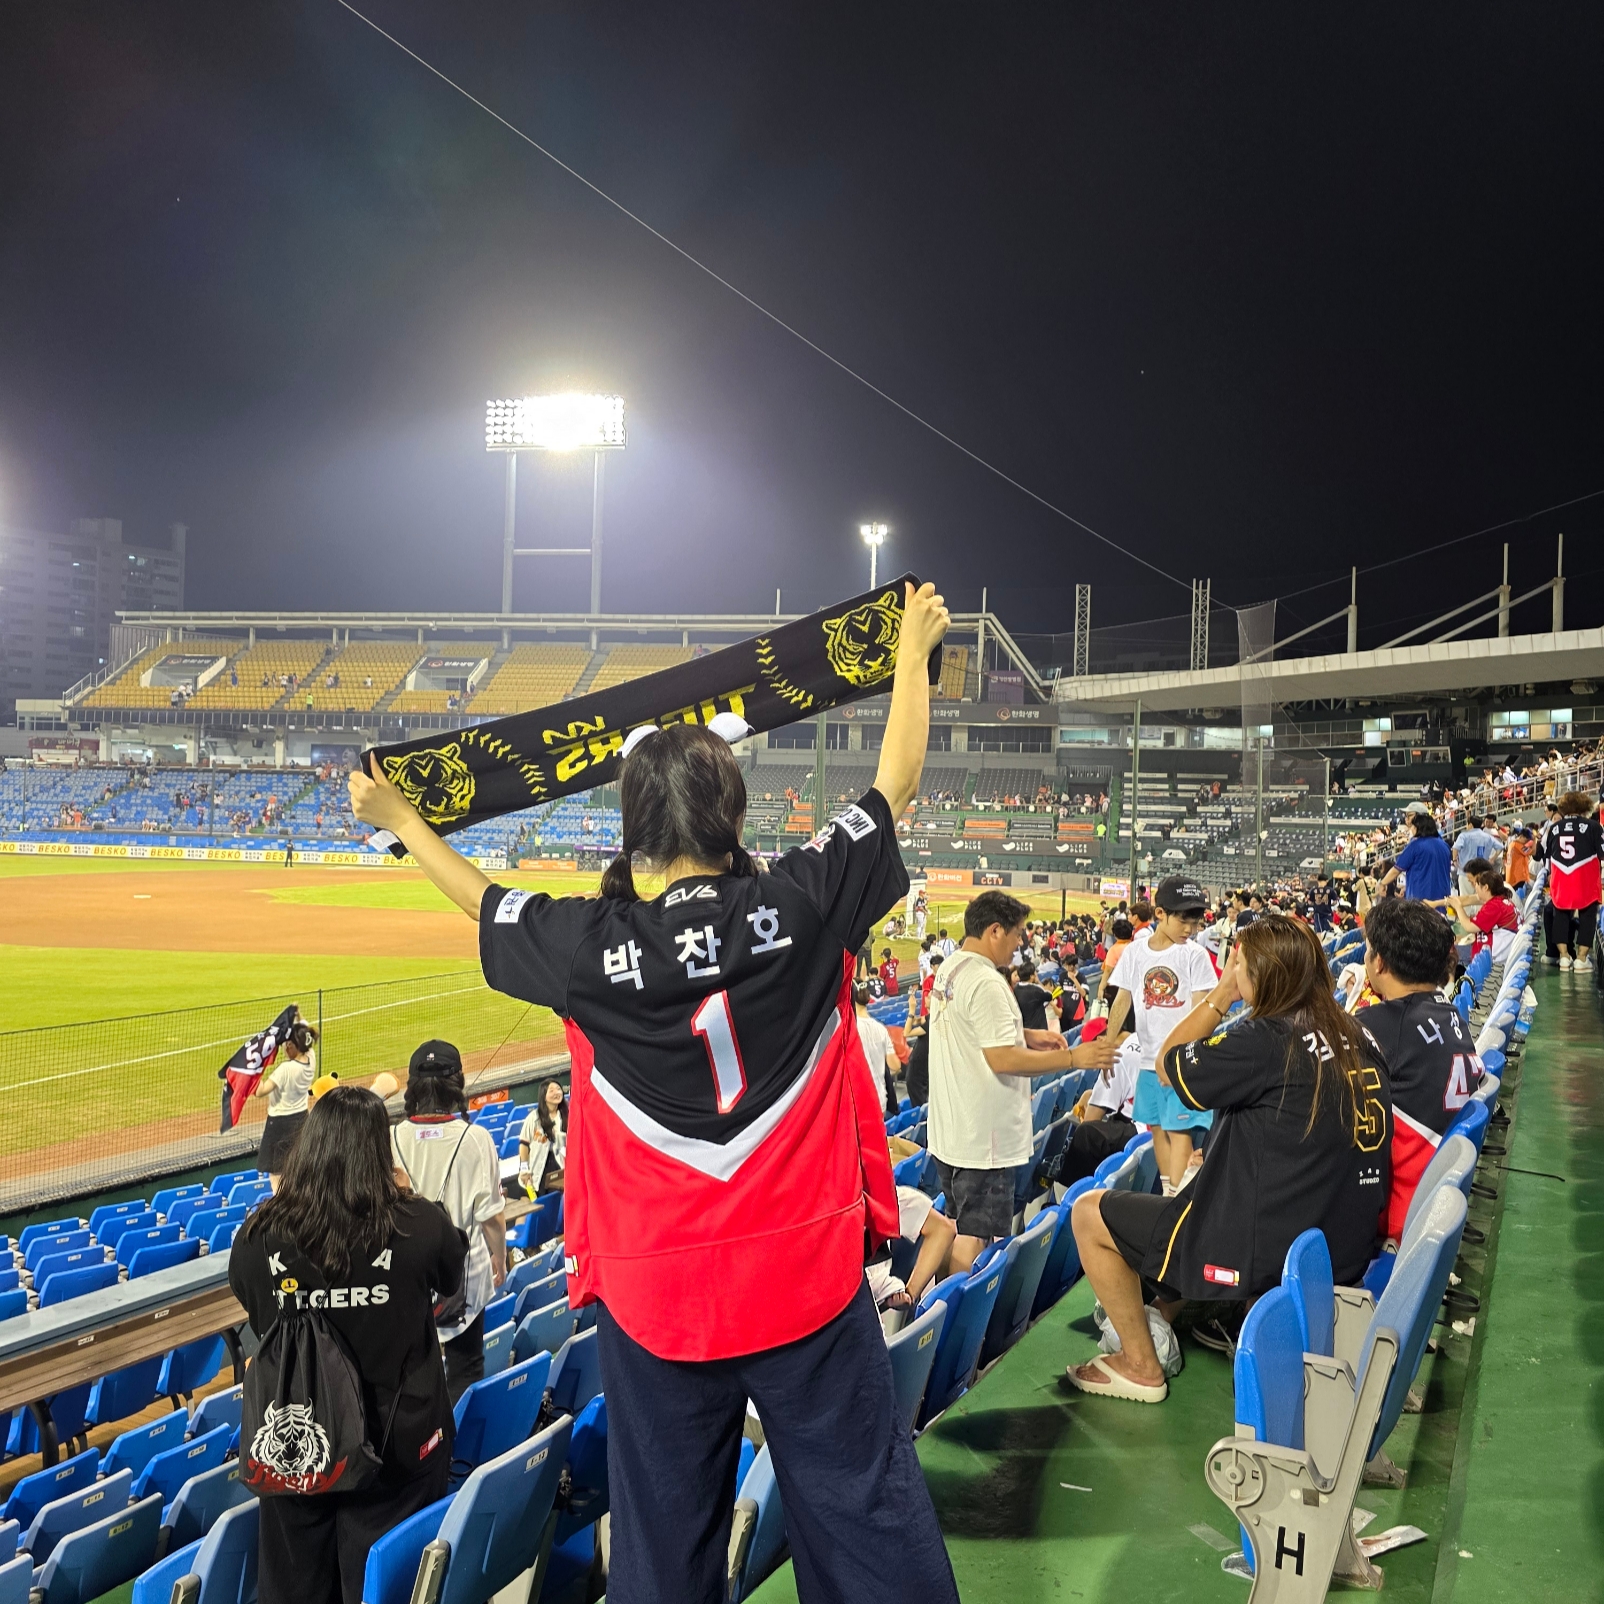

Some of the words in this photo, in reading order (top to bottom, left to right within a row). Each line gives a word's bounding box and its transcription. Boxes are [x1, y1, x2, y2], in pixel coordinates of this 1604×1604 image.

[856, 708, 883, 717] 한화생명
[1011, 710, 1040, 719] 한화생명
[38, 845, 70, 853] BESKO
[94, 846, 126, 854] BESKO
[1560, 836, 1575, 859] 5
[150, 848, 183, 857] BESKO
[208, 850, 240, 859] BESKO
[265, 852, 298, 860] BESO
[324, 854, 358, 863] BESKO
[665, 884, 718, 908] EV6
[603, 905, 792, 990] 박찬호
[889, 969, 895, 978] 5
[690, 989, 748, 1114] 1
[1348, 1067, 1386, 1152] 5
[268, 1248, 393, 1276] KA
[273, 1284, 390, 1310] TIGERS
[1276, 1526, 1306, 1576] H
